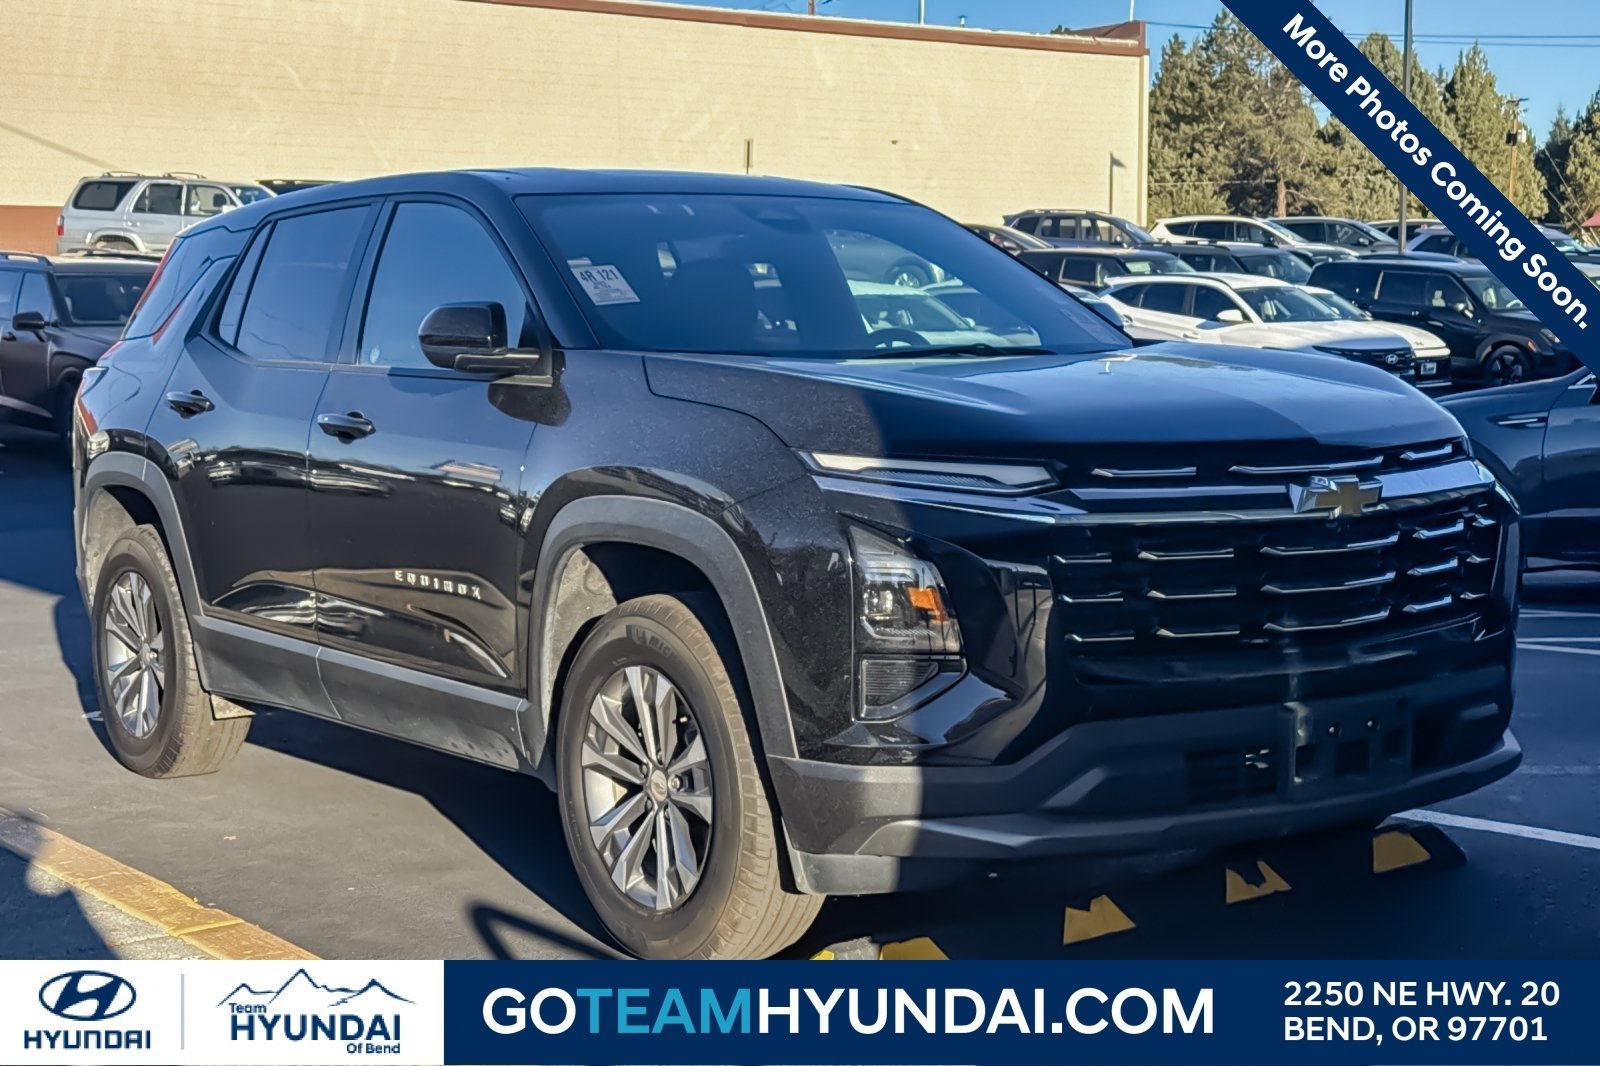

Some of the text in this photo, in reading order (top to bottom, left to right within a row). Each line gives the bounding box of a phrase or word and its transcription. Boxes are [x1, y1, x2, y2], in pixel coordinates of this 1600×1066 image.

[579, 269, 618, 282] 4R 121
[395, 570, 481, 599] EQUINOX
